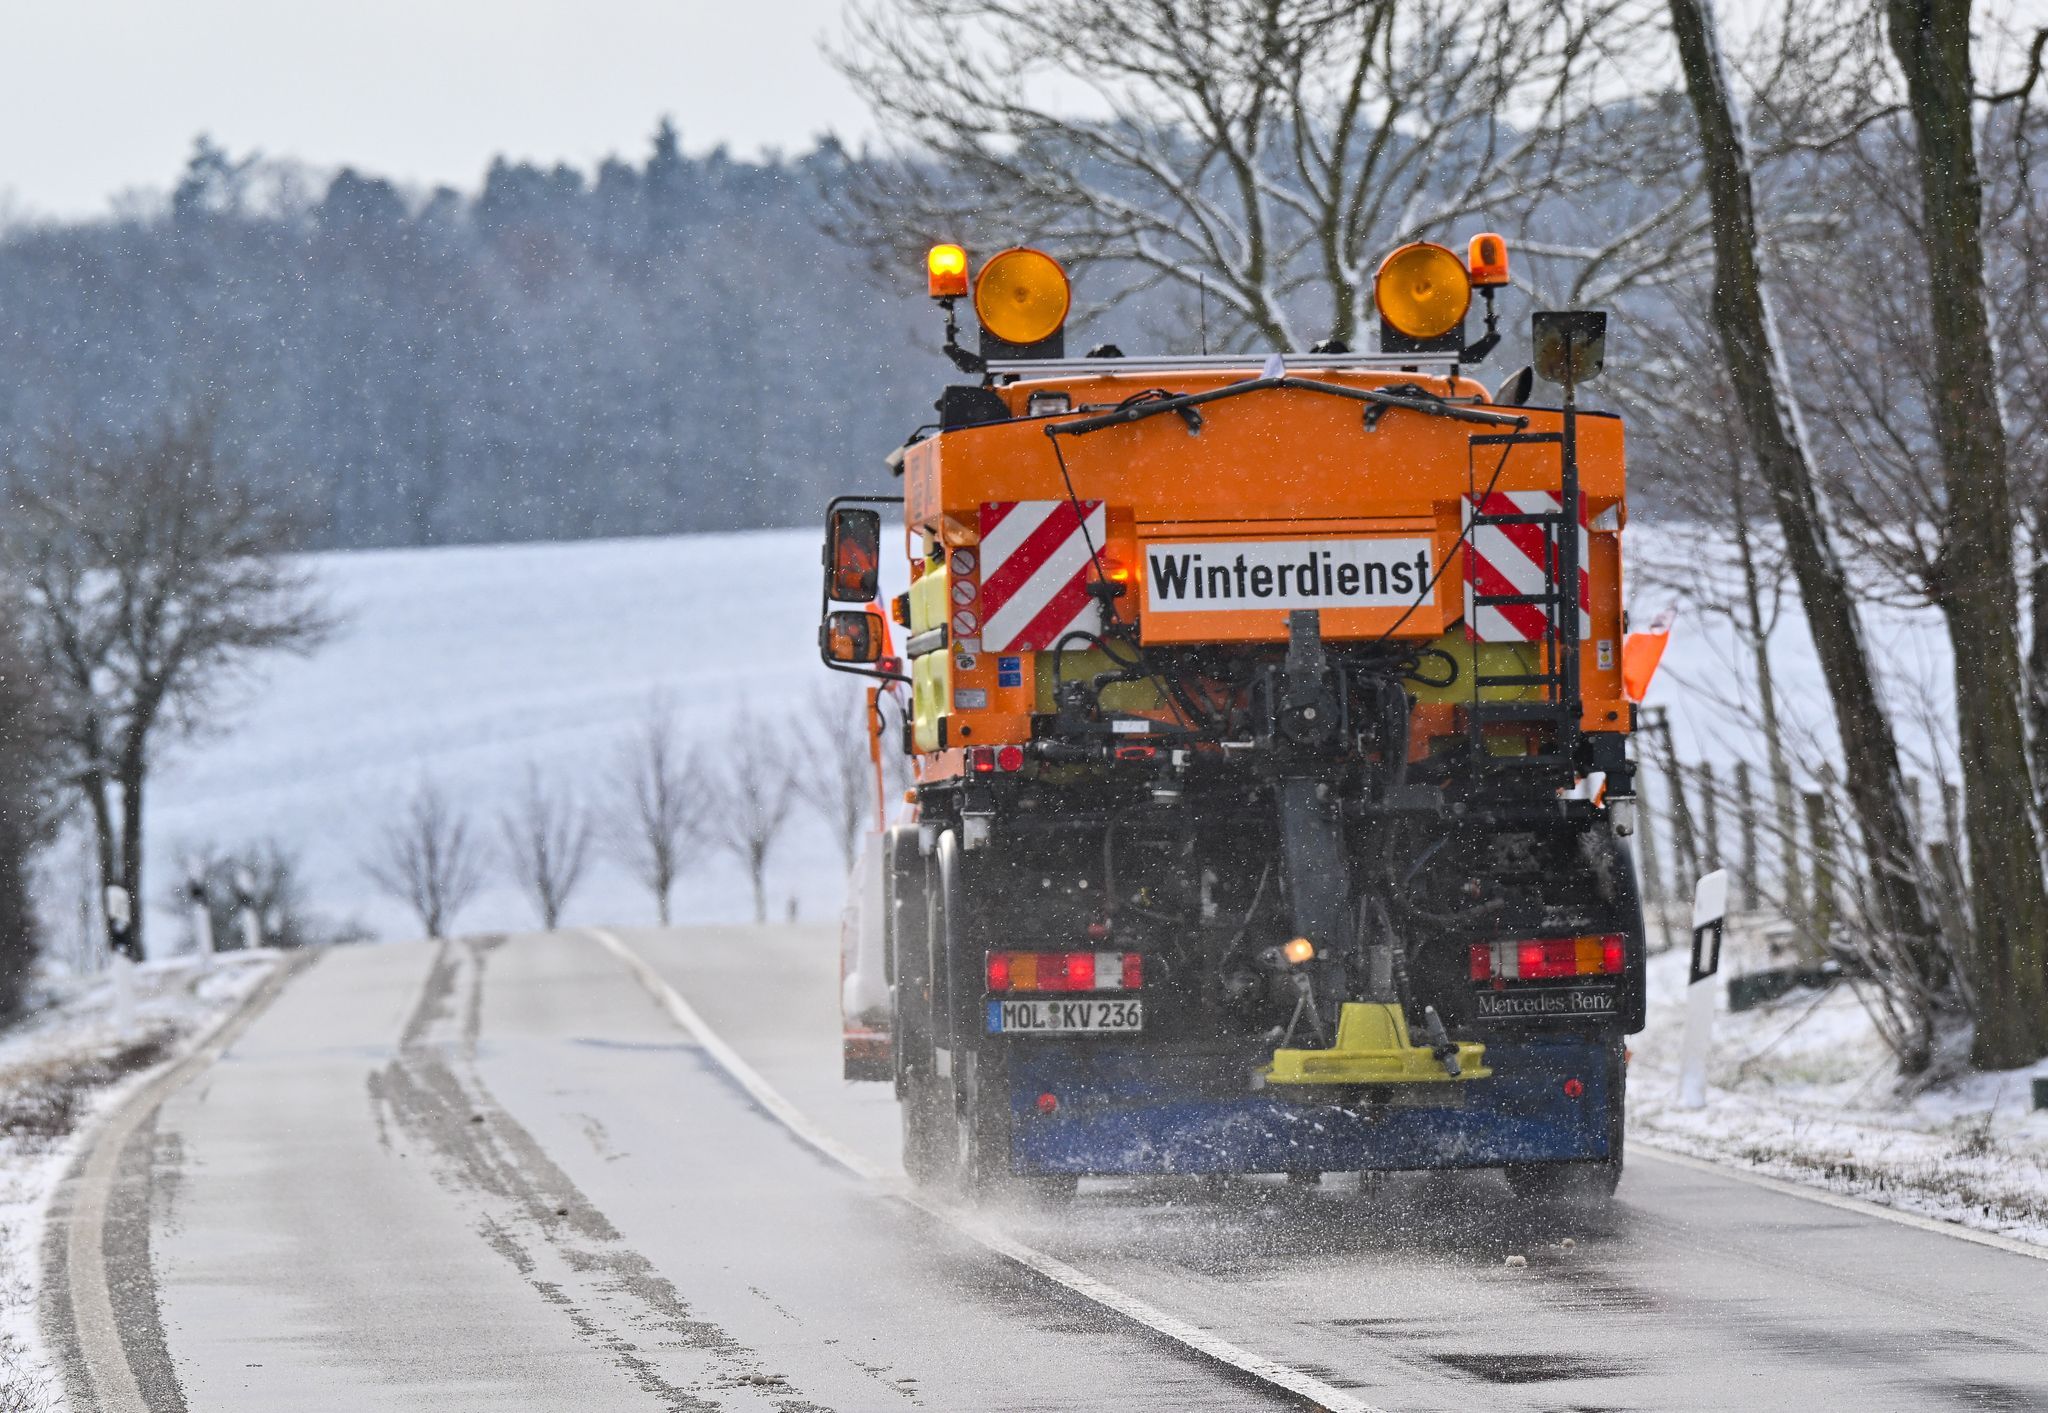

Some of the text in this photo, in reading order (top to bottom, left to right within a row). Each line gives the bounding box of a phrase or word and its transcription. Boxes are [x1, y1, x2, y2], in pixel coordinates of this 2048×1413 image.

[1150, 550, 1429, 599] Winterdienst
[1003, 1003, 1139, 1028] MOL KV 236
